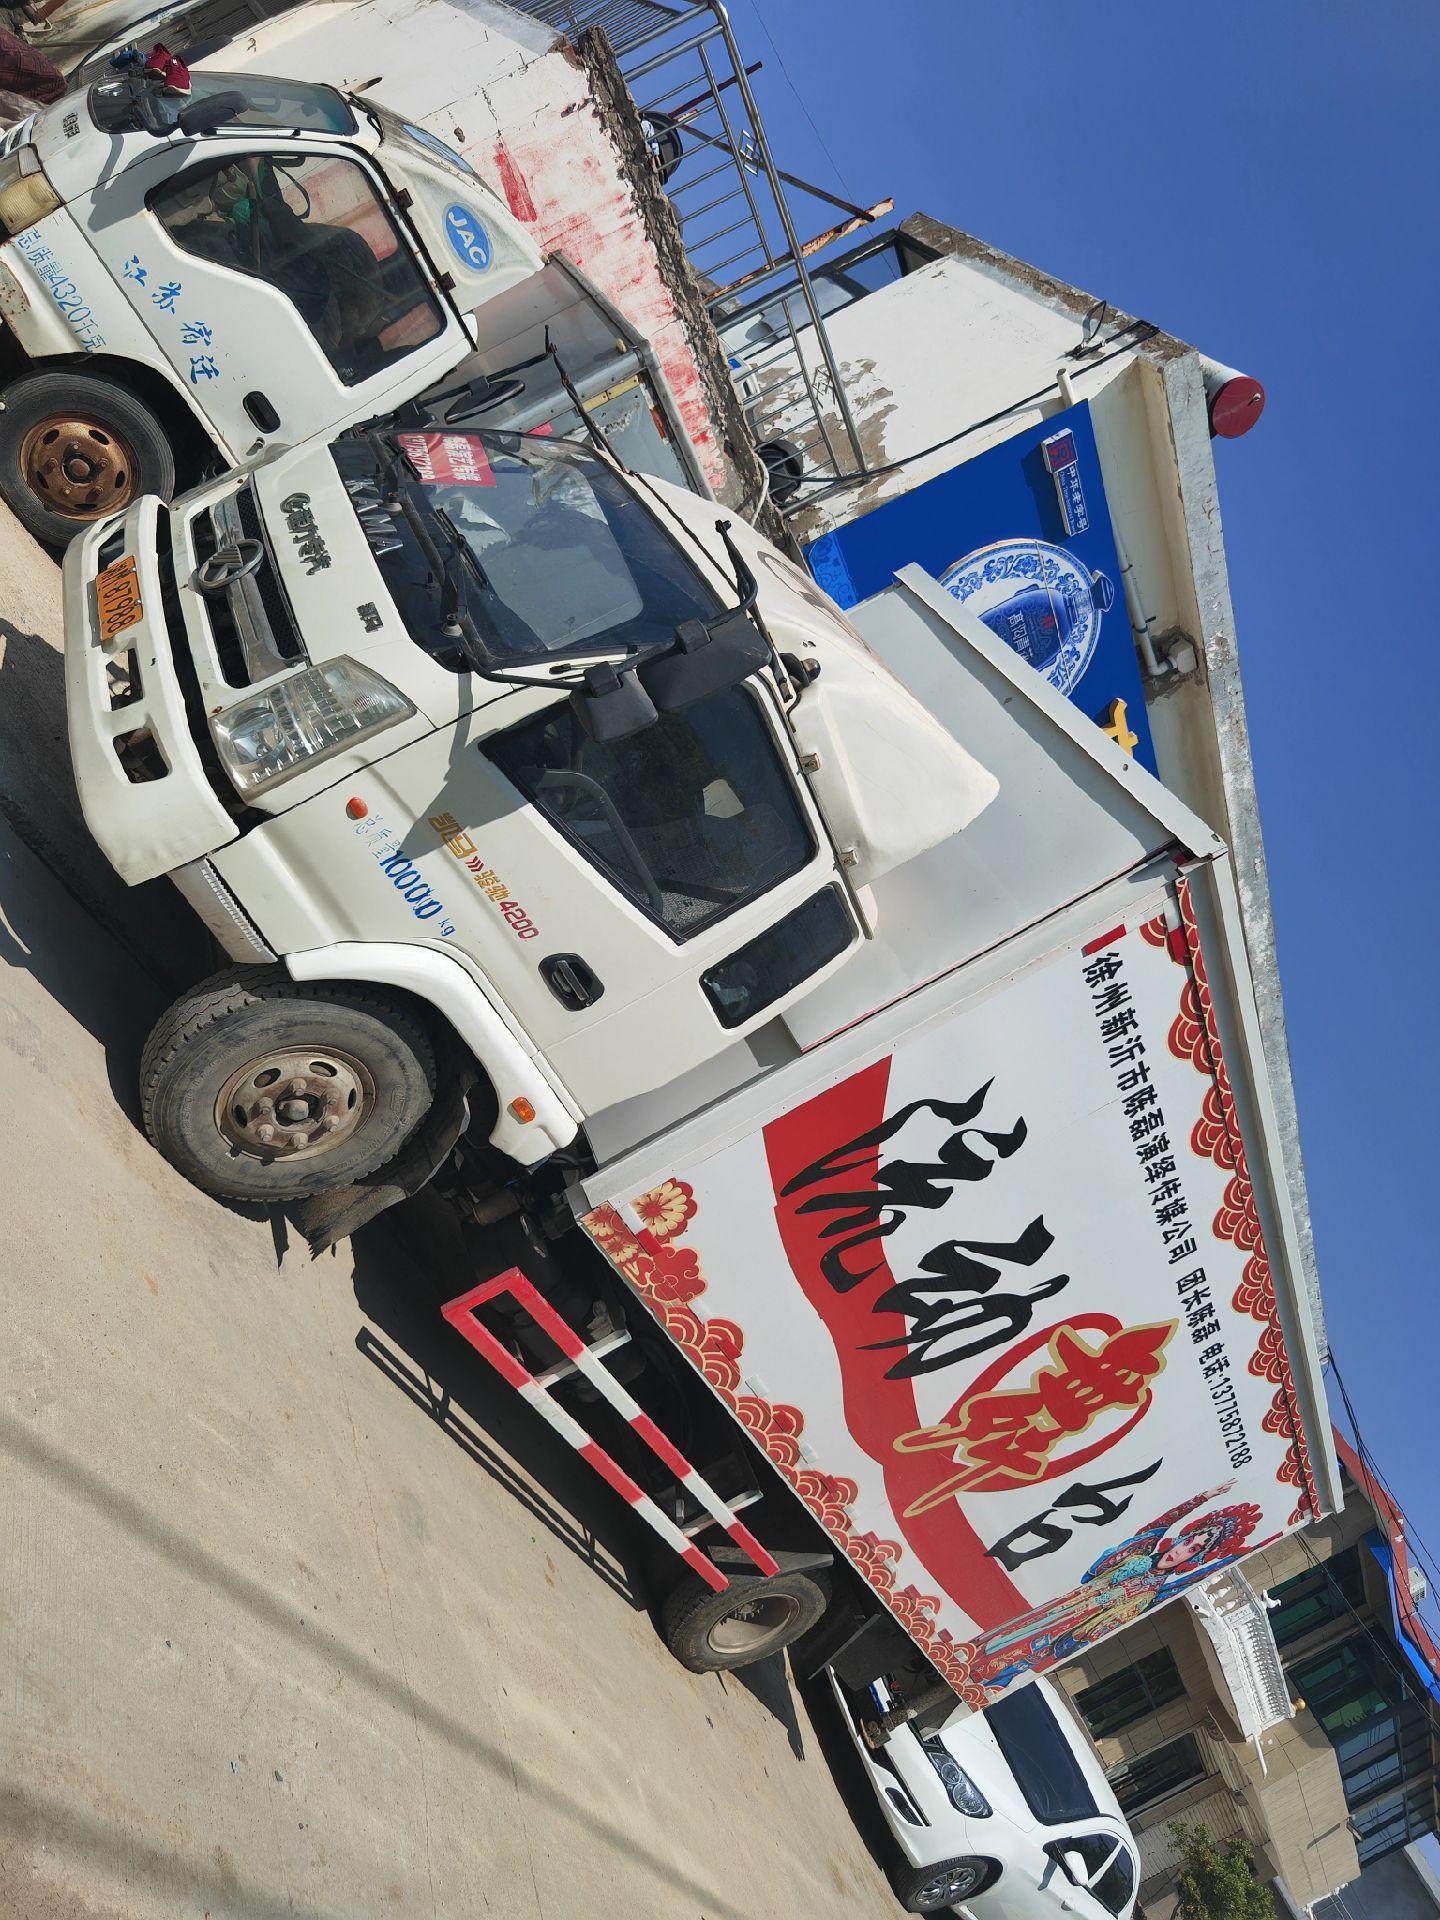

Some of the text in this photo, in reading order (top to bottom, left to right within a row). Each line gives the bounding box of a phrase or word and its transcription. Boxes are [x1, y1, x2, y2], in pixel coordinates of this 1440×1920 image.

[17, 227, 107, 353] 总质量4320千克
[448, 211, 487, 264] JAC
[123, 254, 220, 384] 江苏宿迁
[345, 478, 404, 556] KAMA
[1067, 466, 1087, 529] 中华老字号
[1082, 952, 1197, 1265] 徐州新沂市陈磊演绎传媒公司
[780, 1076, 1180, 1572] 流动舞台
